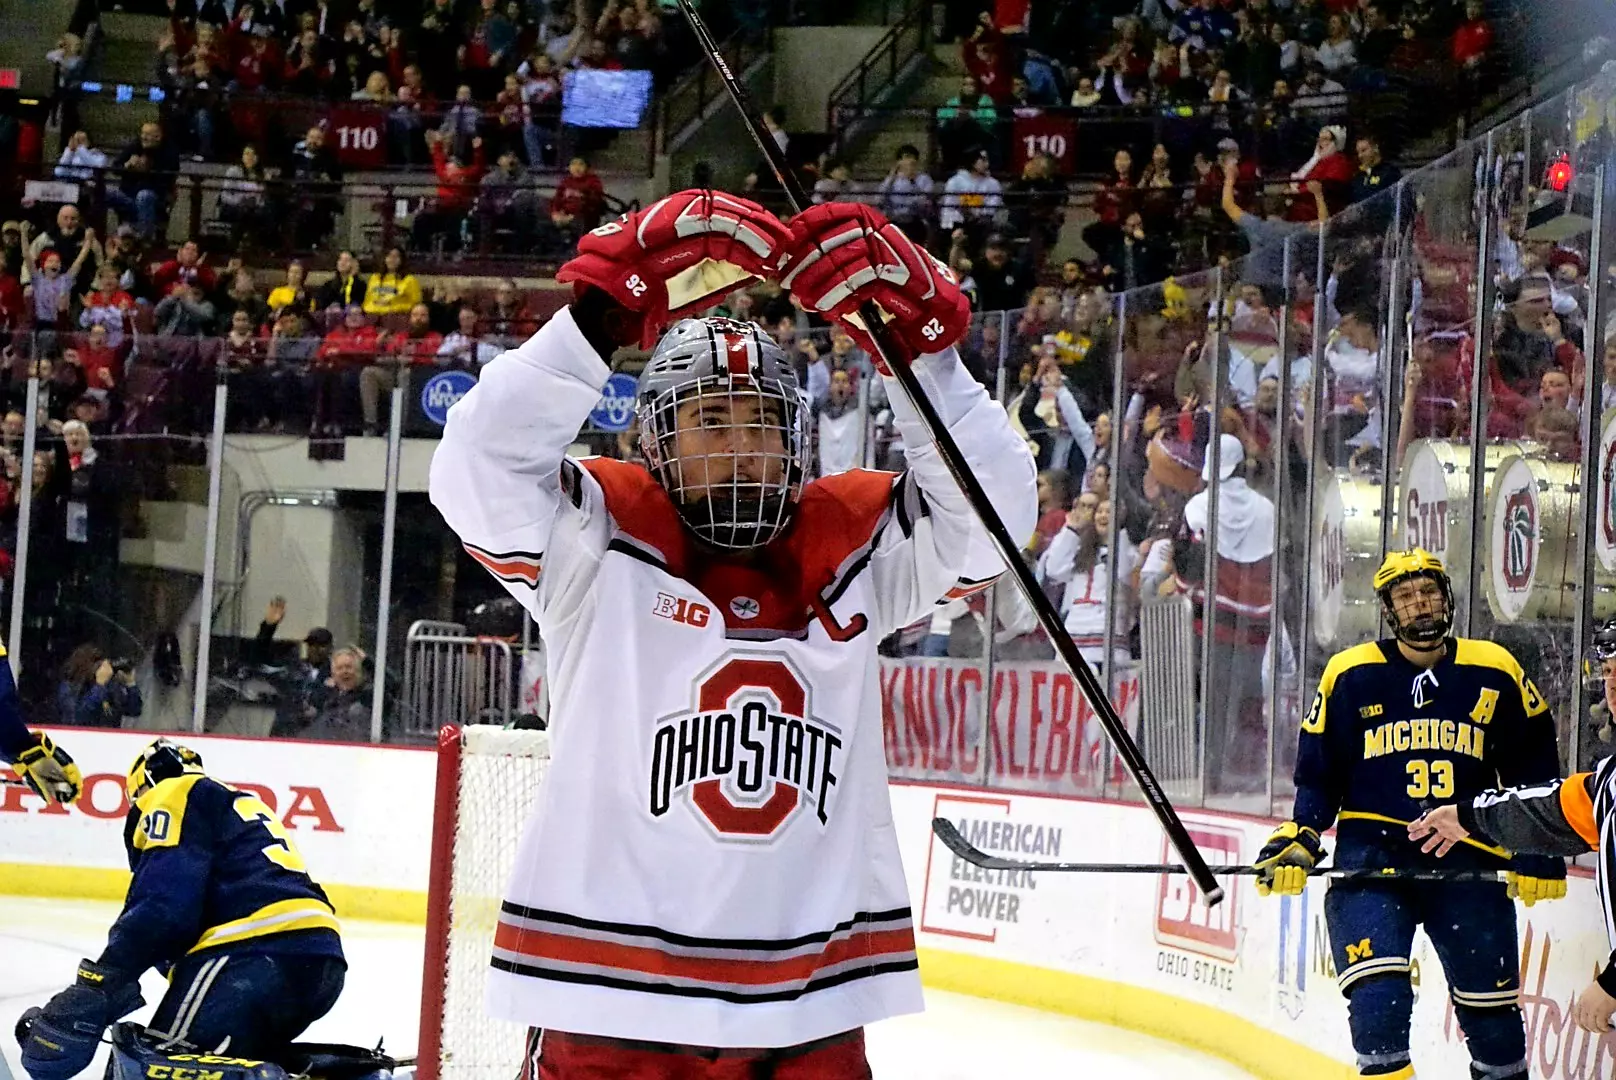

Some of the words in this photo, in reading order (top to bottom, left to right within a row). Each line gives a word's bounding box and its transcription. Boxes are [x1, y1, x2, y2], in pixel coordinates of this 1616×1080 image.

[336, 126, 379, 150] 110
[1023, 134, 1067, 158] 110
[625, 273, 648, 298] 26
[921, 317, 945, 342] 26
[1469, 686, 1500, 725] A
[1363, 718, 1485, 762] MICHIGAN
[1405, 758, 1455, 800] 33
[956, 818, 1062, 857] AMERICAN
[946, 886, 1020, 923] POWER
[1345, 938, 1374, 964] M
[1157, 951, 1189, 978] OHIO
[1193, 960, 1234, 992] STATE
